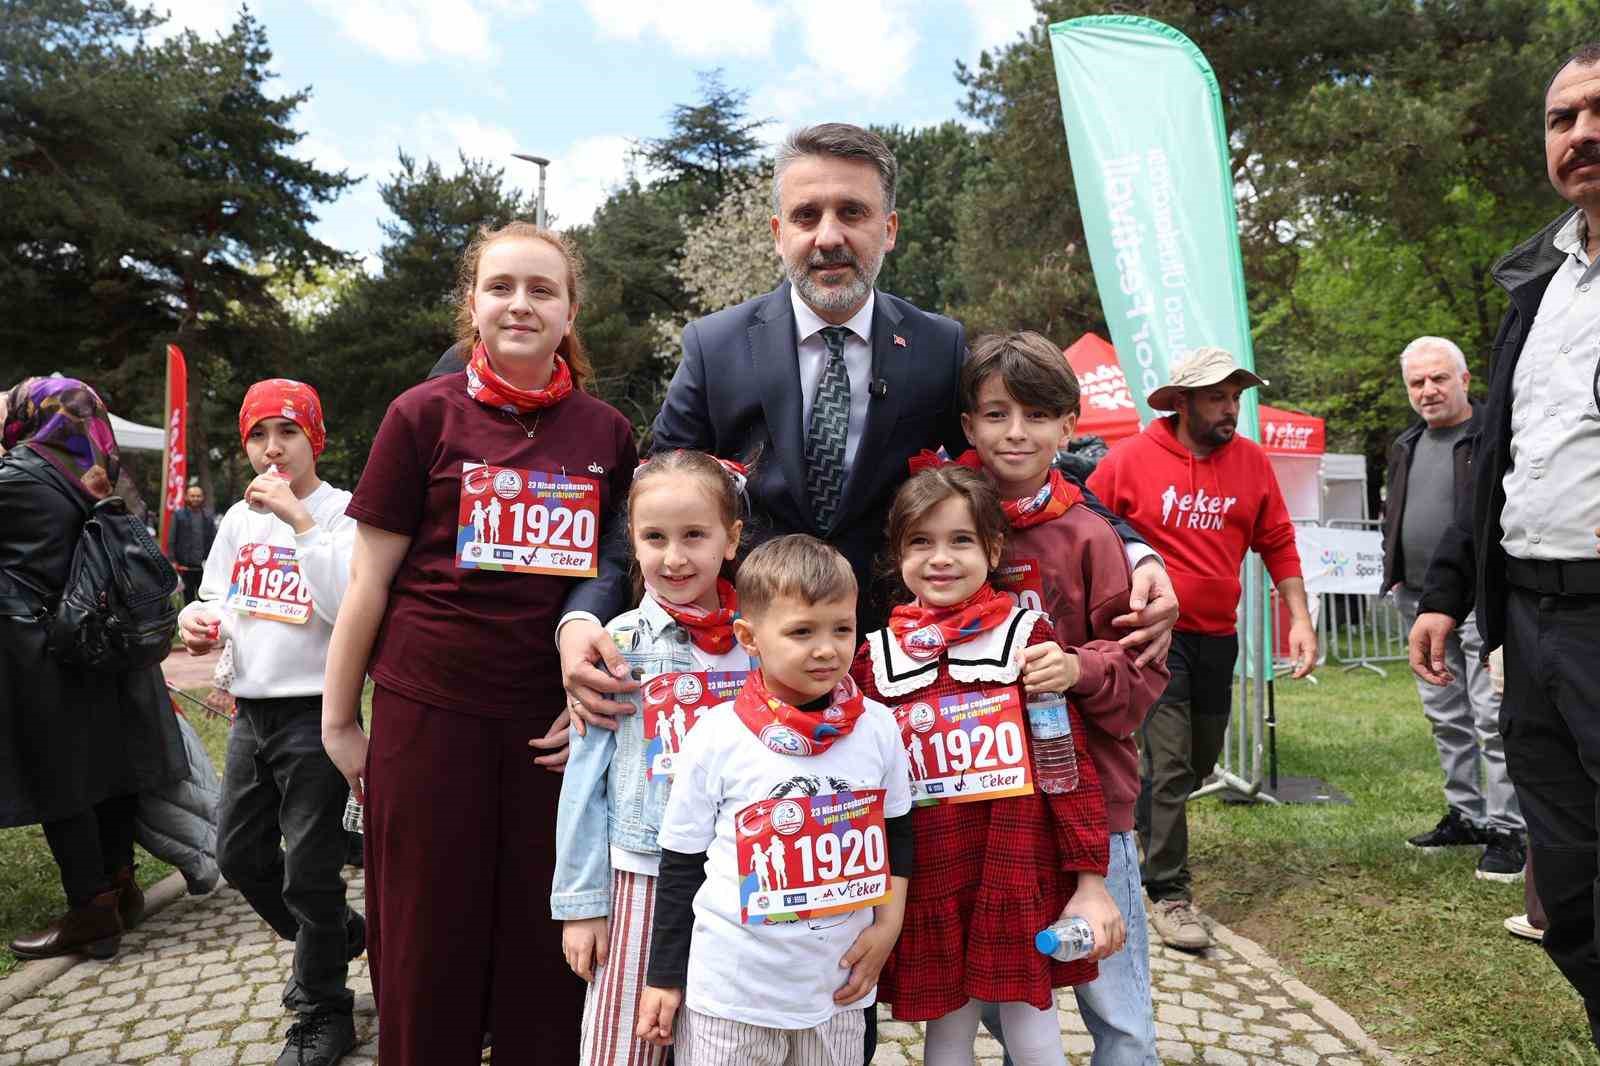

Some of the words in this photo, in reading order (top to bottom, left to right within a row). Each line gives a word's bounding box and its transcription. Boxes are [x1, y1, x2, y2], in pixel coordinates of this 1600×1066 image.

[1276, 422, 1314, 440] eker
[1282, 439, 1308, 449] RUN
[1179, 488, 1237, 514] eker
[510, 503, 595, 549] 1920
[1187, 513, 1224, 531] RUN
[1355, 564, 1375, 578] Spor
[259, 568, 312, 604] 1920
[929, 721, 1024, 773] 1920
[794, 825, 885, 882] 1920
